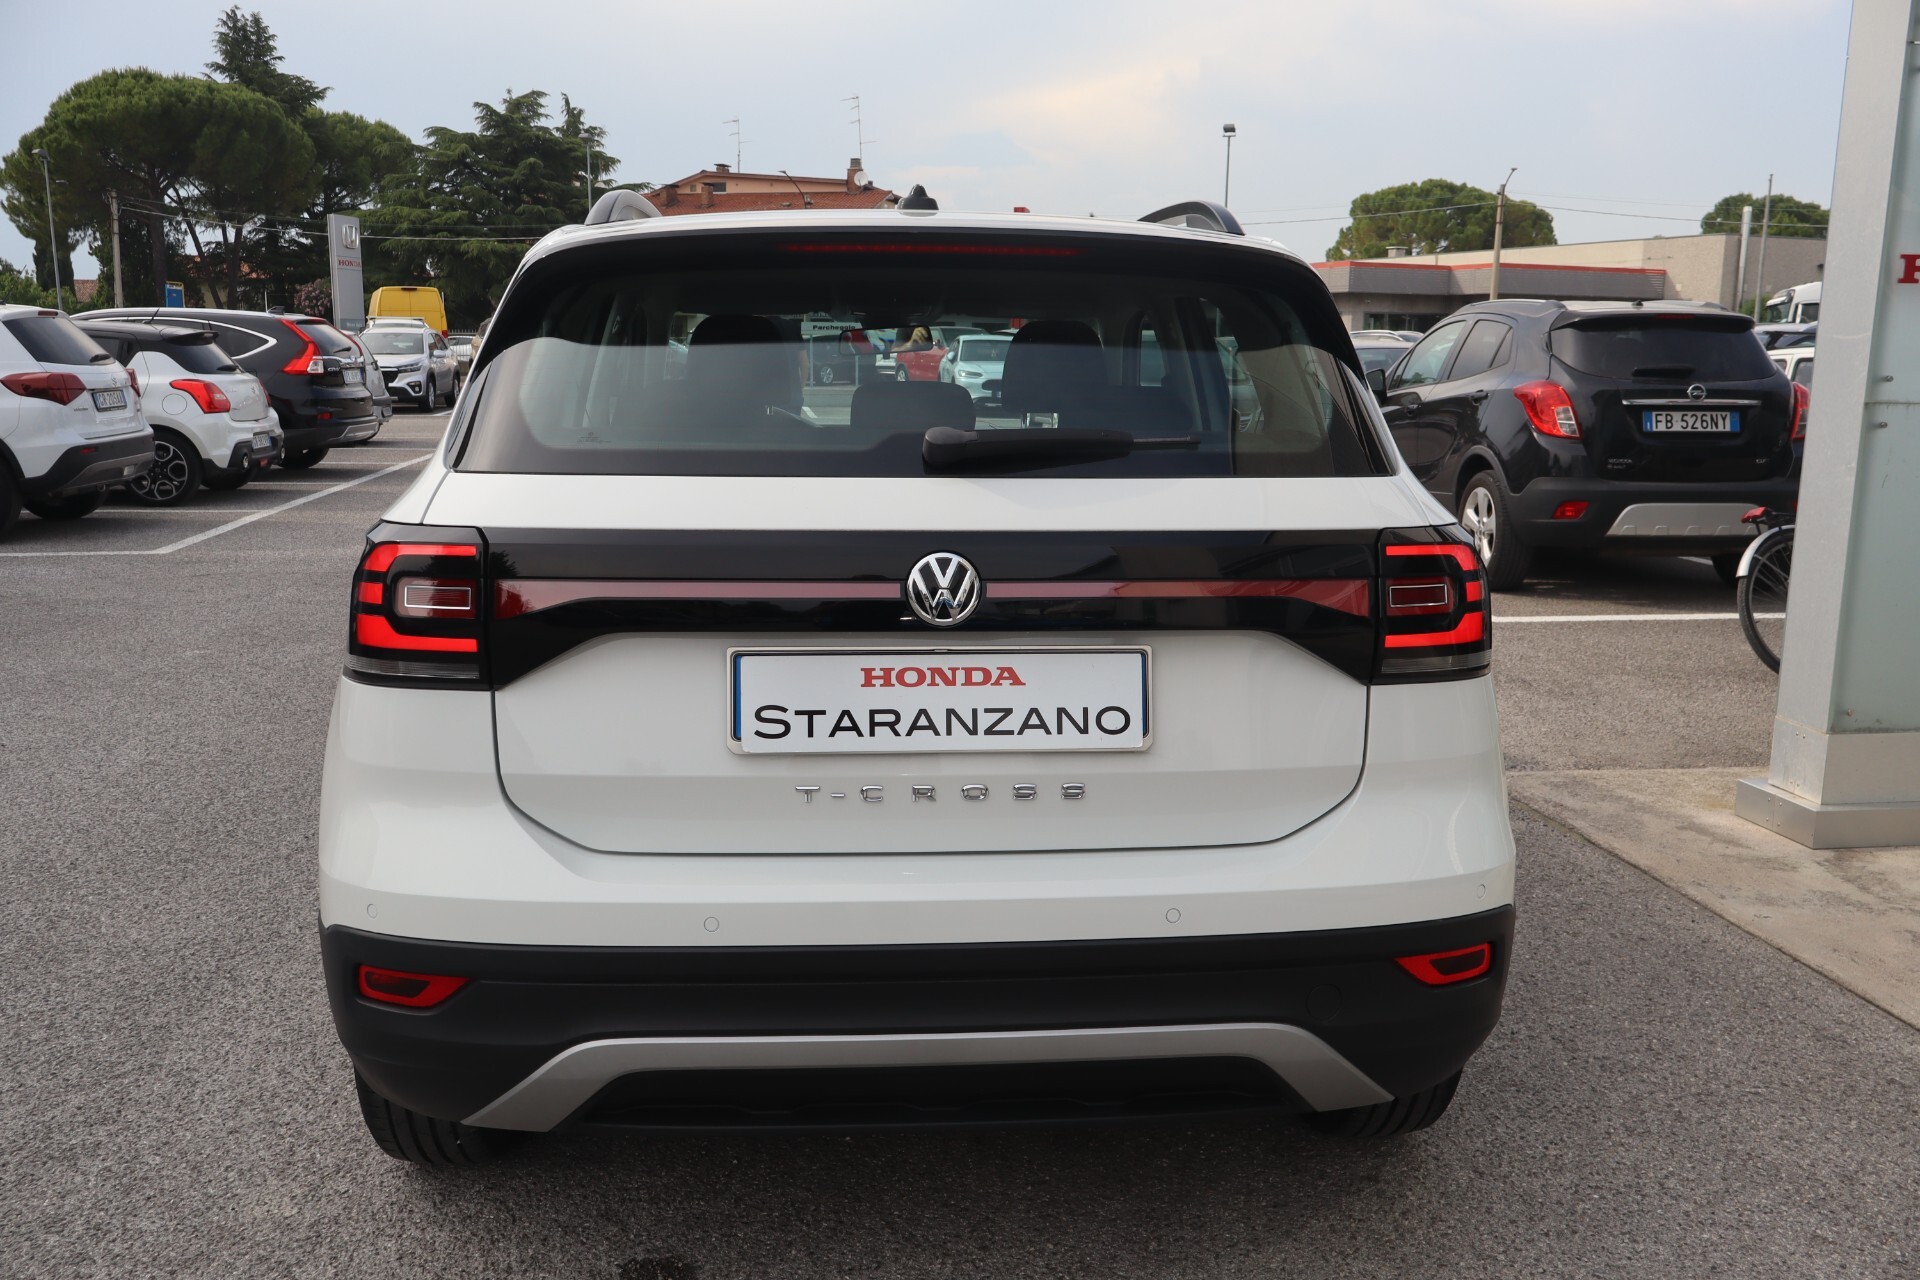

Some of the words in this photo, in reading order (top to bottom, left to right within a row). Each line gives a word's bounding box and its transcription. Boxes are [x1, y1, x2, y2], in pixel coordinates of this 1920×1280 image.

[1655, 413, 1674, 430] FB
[1680, 412, 1729, 430] 526NY
[860, 666, 1026, 688] HONDA
[753, 704, 1131, 740] STARANZANO
[795, 782, 1086, 803] T-CROSS
